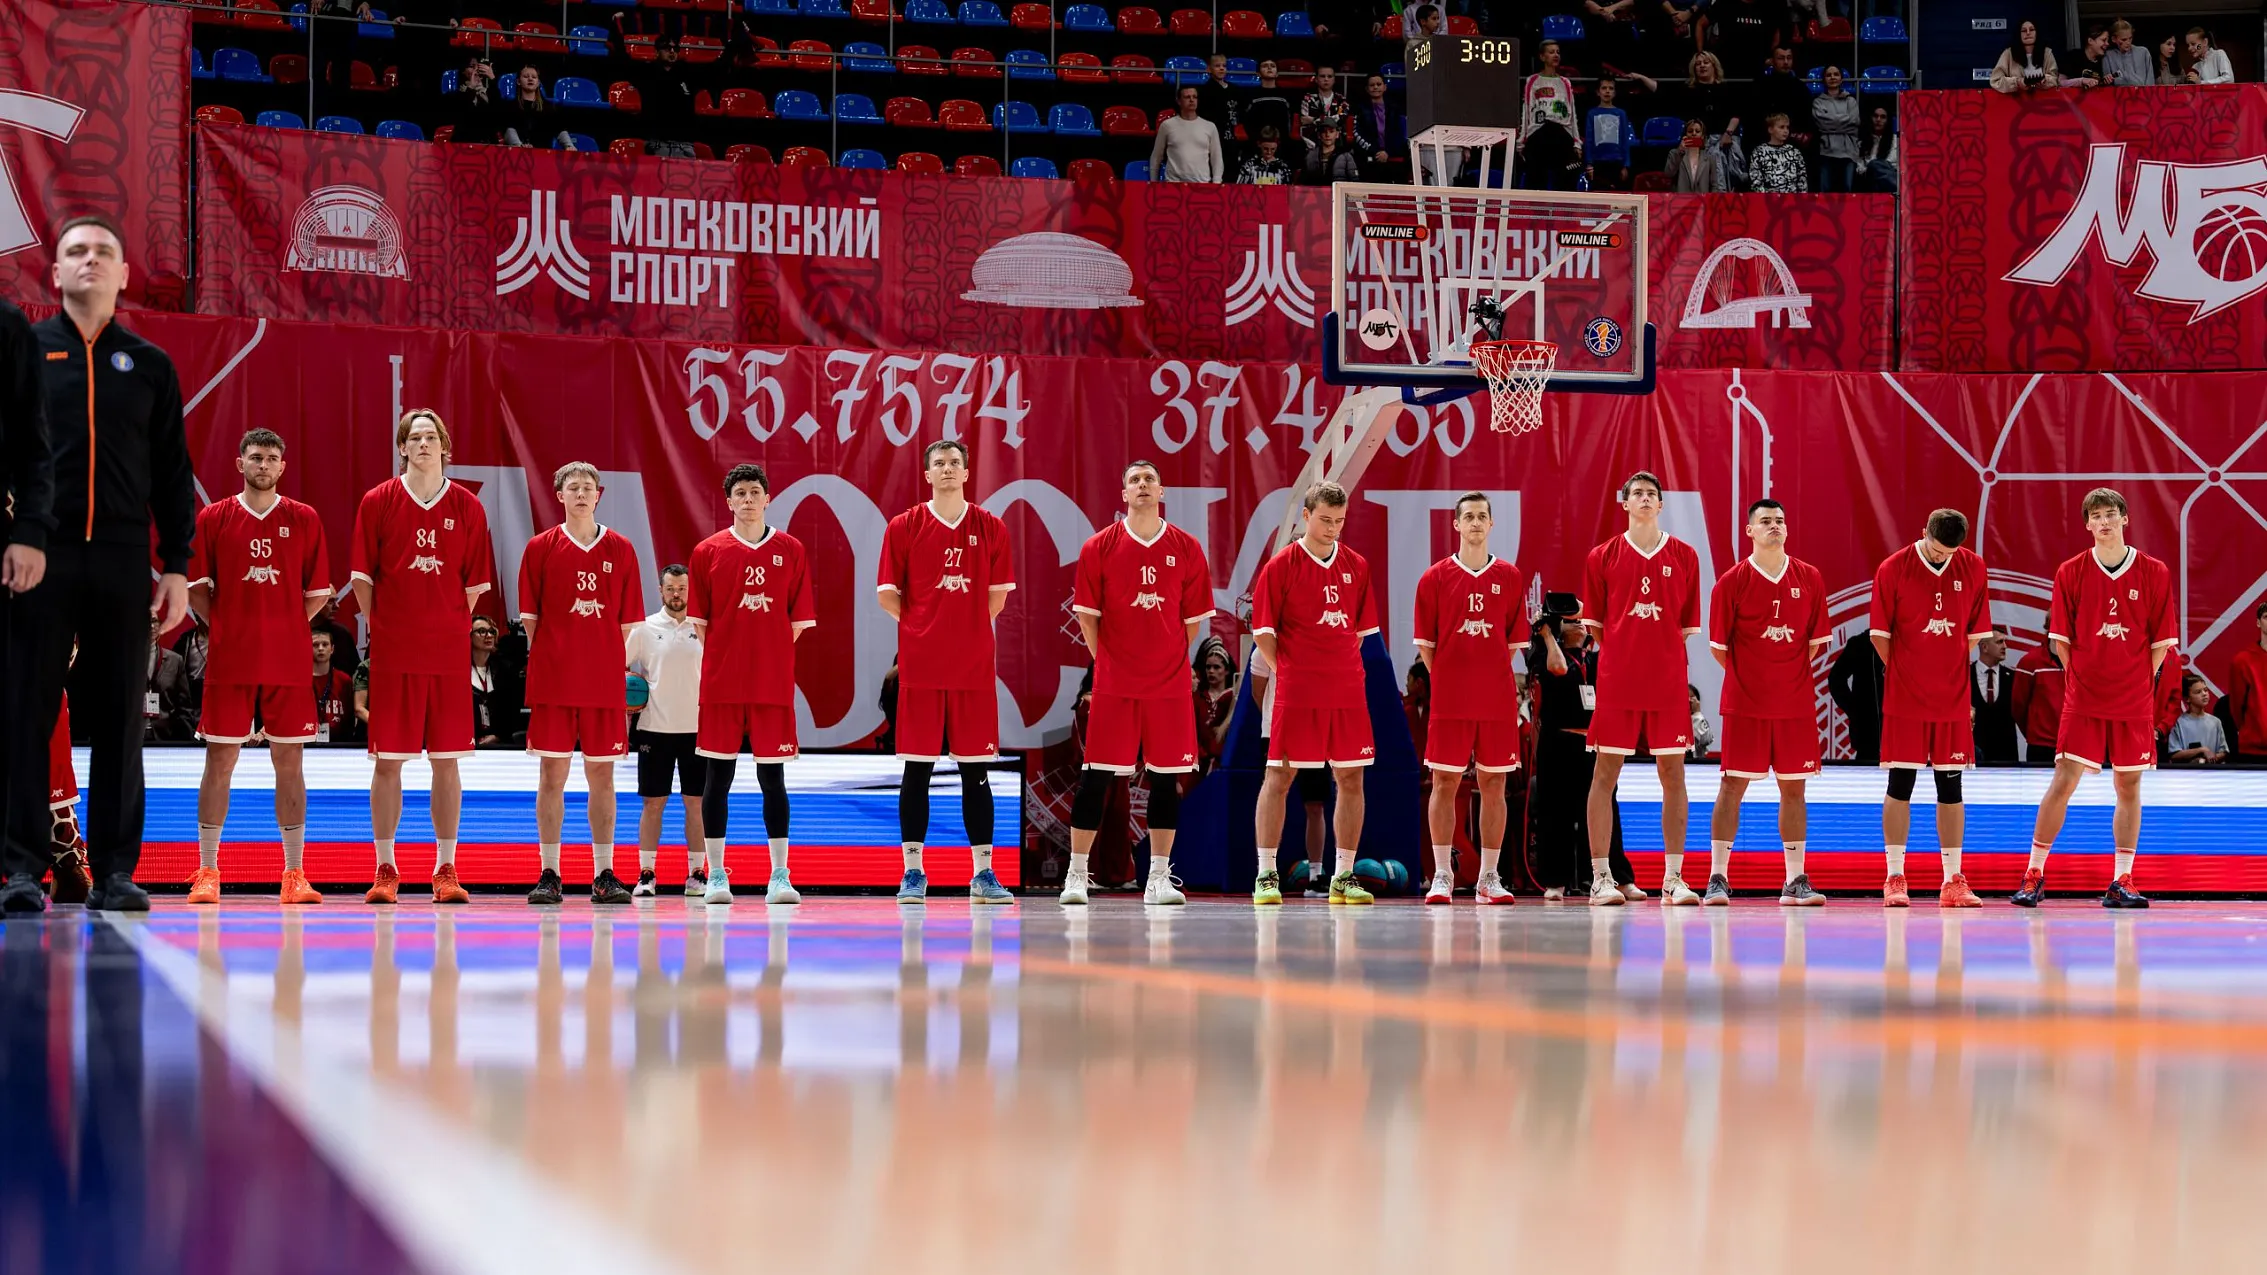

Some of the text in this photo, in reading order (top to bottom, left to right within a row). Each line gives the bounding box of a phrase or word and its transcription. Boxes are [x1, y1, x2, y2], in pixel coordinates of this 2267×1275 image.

[1414, 41, 1431, 72] 3:00
[1460, 40, 1510, 64] 3:00
[611, 195, 880, 259] МОСКОВСКИЙ
[1365, 226, 1414, 238] WINLINE
[2001, 142, 2267, 326] МБ
[1561, 234, 1608, 246] WINLINE
[611, 252, 735, 308] СПОРТ
[1346, 282, 1448, 331] ПОР
[683, 348, 1031, 450] 55.7574
[1150, 360, 1476, 457] 37.465
[249, 538, 273, 559] 95
[416, 528, 437, 549] 84
[944, 547, 964, 568] 27
[576, 570, 597, 592] 38
[744, 565, 766, 586] 28
[1140, 565, 1157, 585] 16
[1640, 576, 1651, 595] 8
[1322, 584, 1340, 604] 15
[1467, 592, 1484, 613] 13
[1934, 592, 1943, 611] 3
[1772, 599, 1781, 619] 7
[2108, 597, 2118, 616] 2
